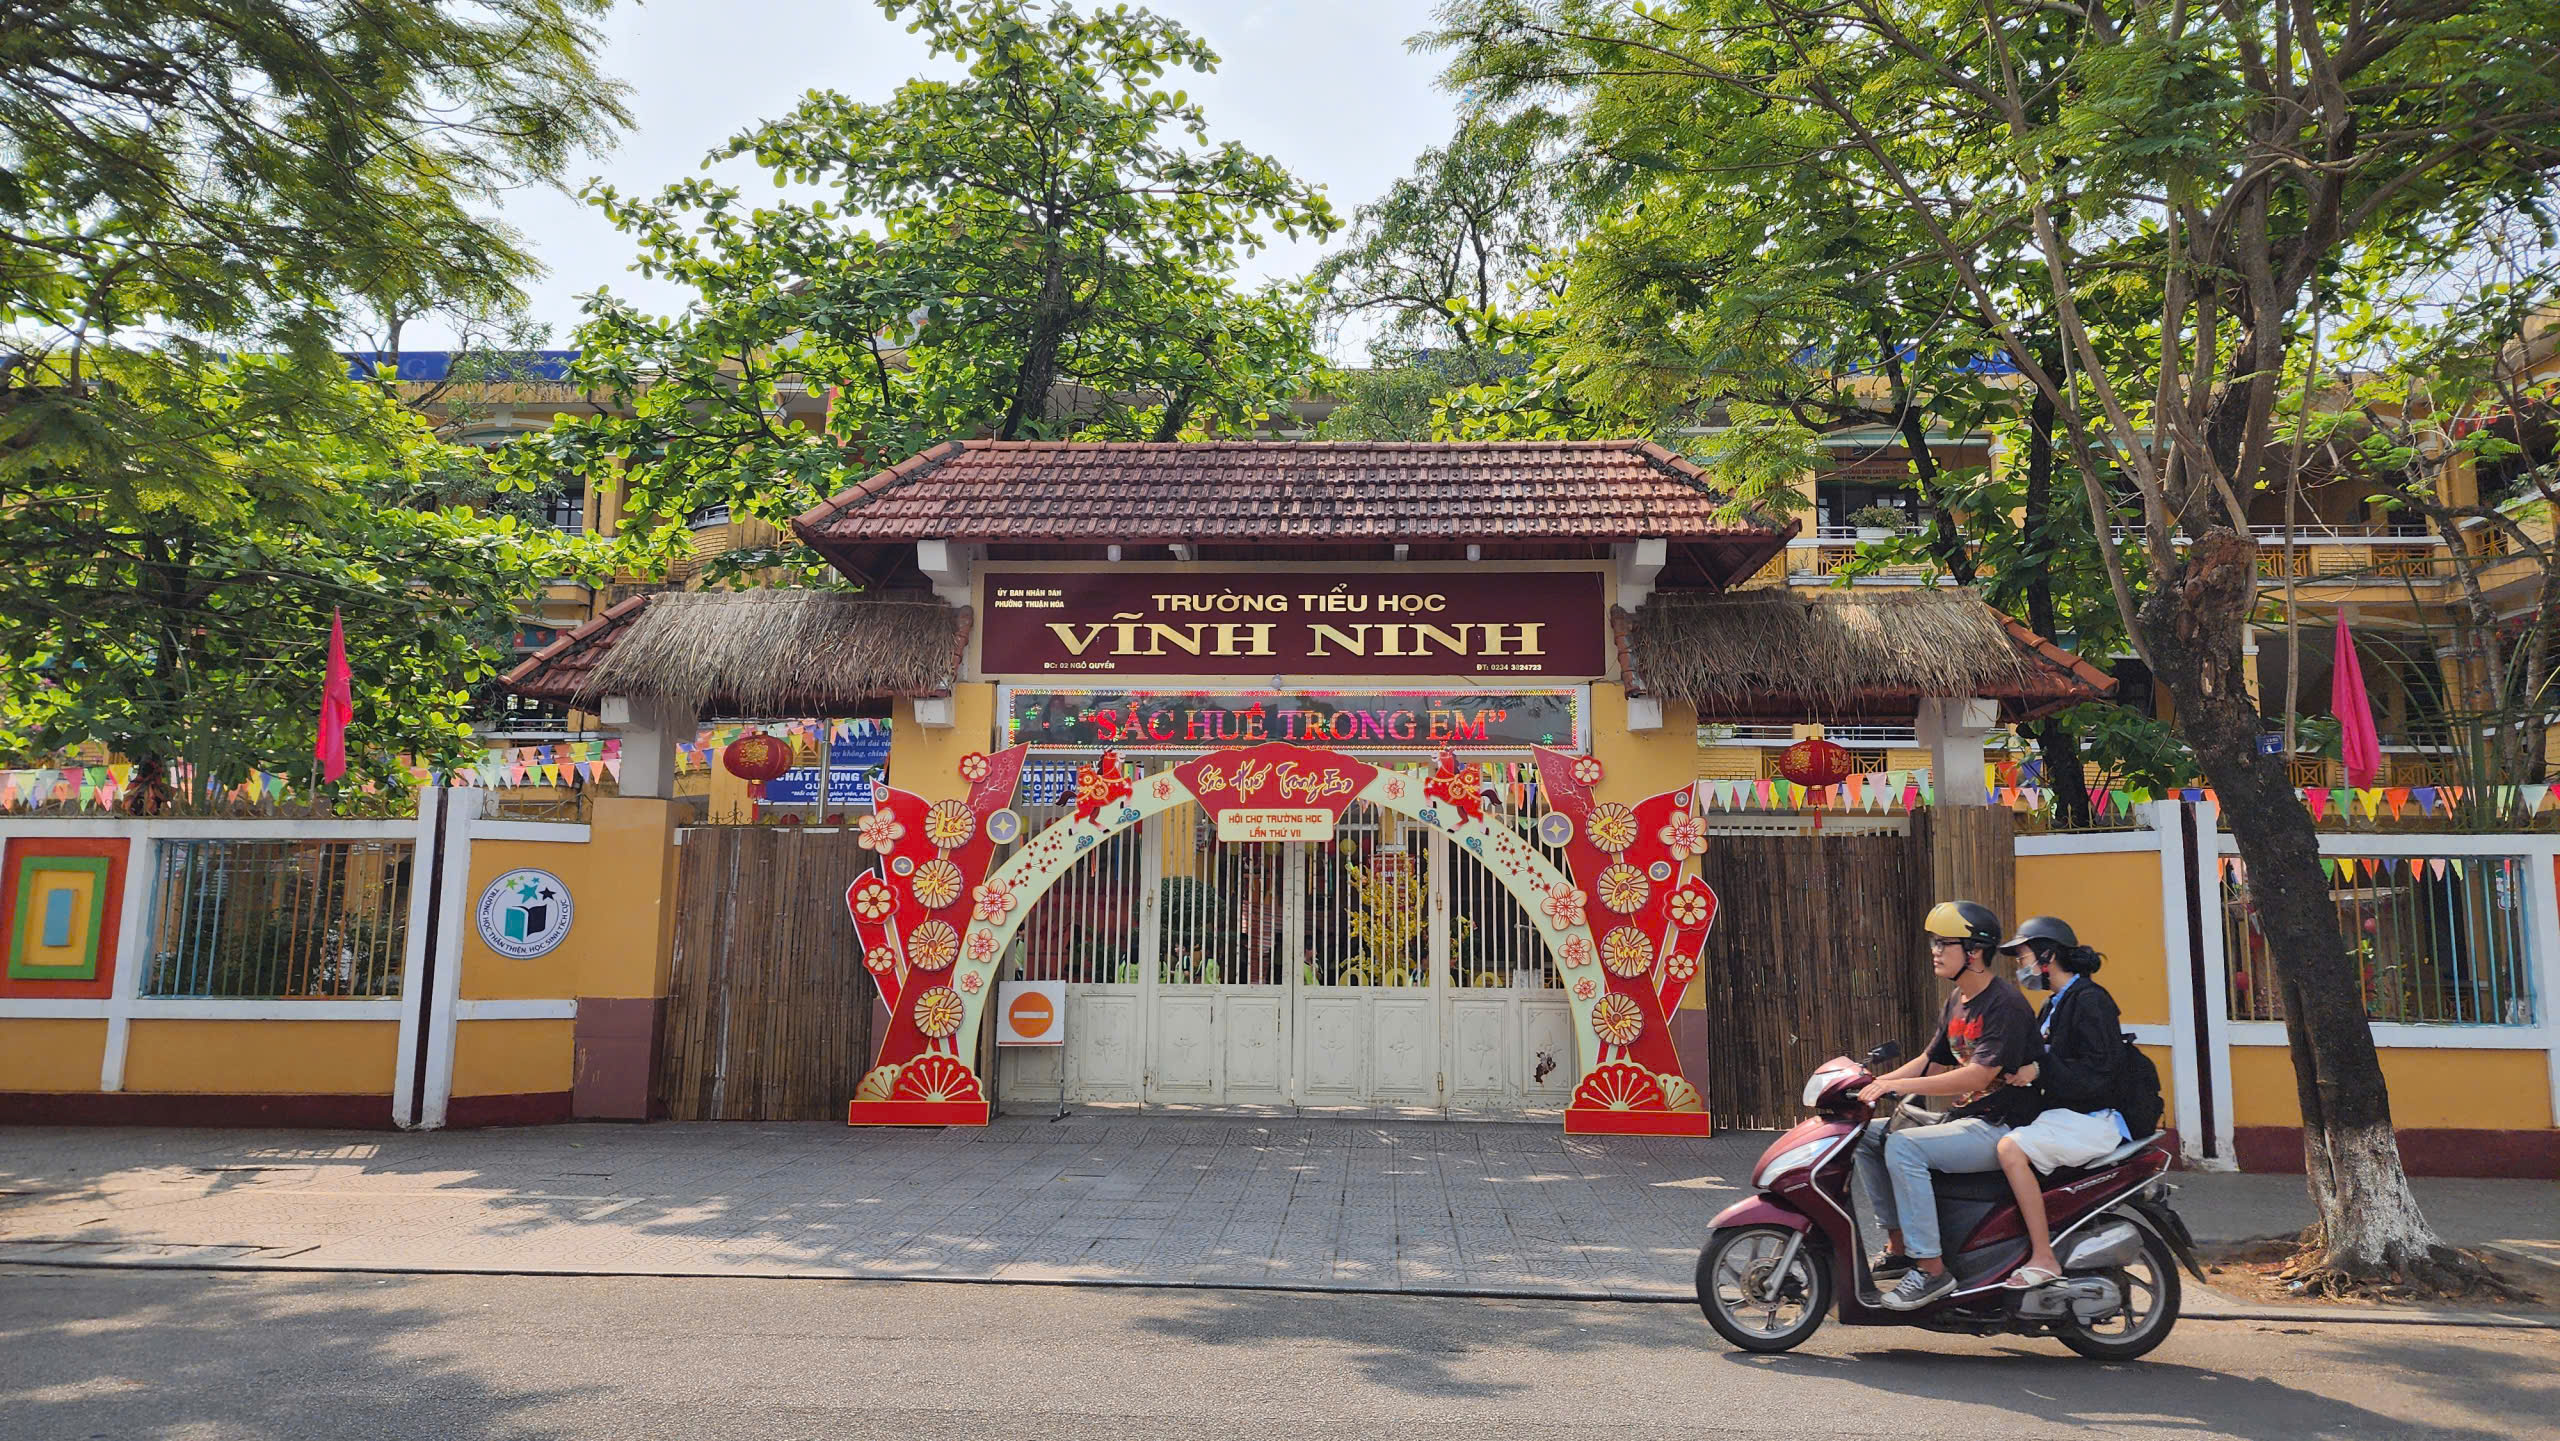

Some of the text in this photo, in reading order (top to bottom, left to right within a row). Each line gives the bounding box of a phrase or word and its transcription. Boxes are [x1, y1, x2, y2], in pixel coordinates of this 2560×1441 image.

[1152, 583, 1446, 616] TRƯỜNG TIỂU HỌC
[1045, 612, 1546, 656] VĨNH NINH
[1044, 661, 1058, 669] ĐC:
[1070, 660, 1087, 669] NGÔ
[1476, 663, 1490, 671] ĐT:
[1184, 701, 1268, 741] HUẾ
[1277, 709, 1417, 741] TRONG
[814, 771, 860, 783] LỢNG
[1228, 812, 1323, 824] HỘI CHỢ TRƯỜNG HỌC
[1249, 825, 1301, 837] LẦN THỨ VII
[483, 917, 492, 932] HỌC
[489, 932, 506, 947] THÂN
[529, 942, 546, 952] HỌC
[546, 932, 561, 945] SINH
